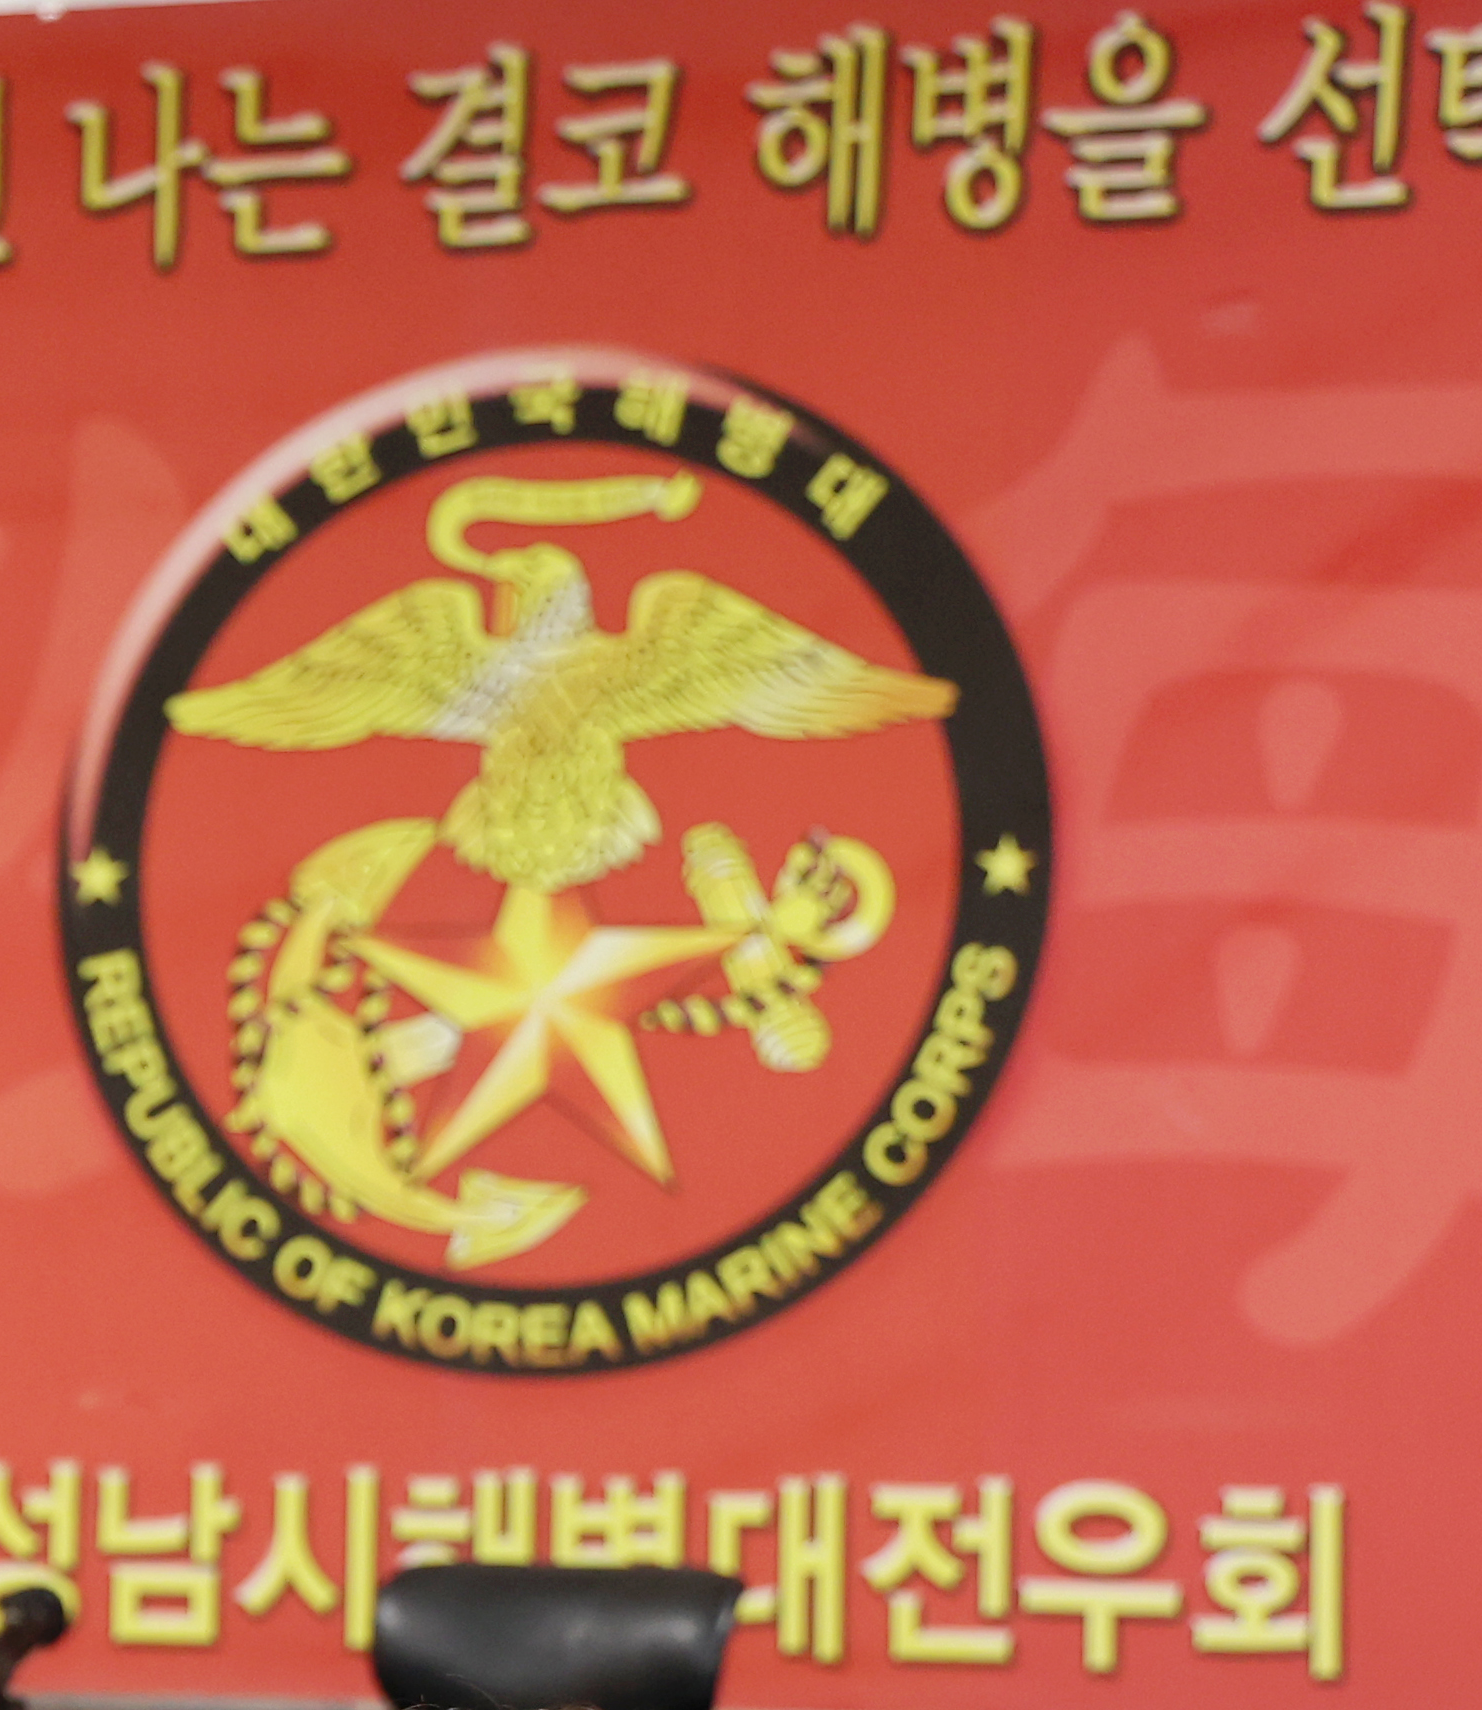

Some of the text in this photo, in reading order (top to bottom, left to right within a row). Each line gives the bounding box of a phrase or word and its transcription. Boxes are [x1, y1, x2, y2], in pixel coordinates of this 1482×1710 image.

[66, 61, 351, 267] 나는
[400, 41, 688, 249] 결코
[747, 10, 1207, 236] 해병을
[76, 941, 1018, 1368] REPUBLIC OF KOREA MARINE CORPS
